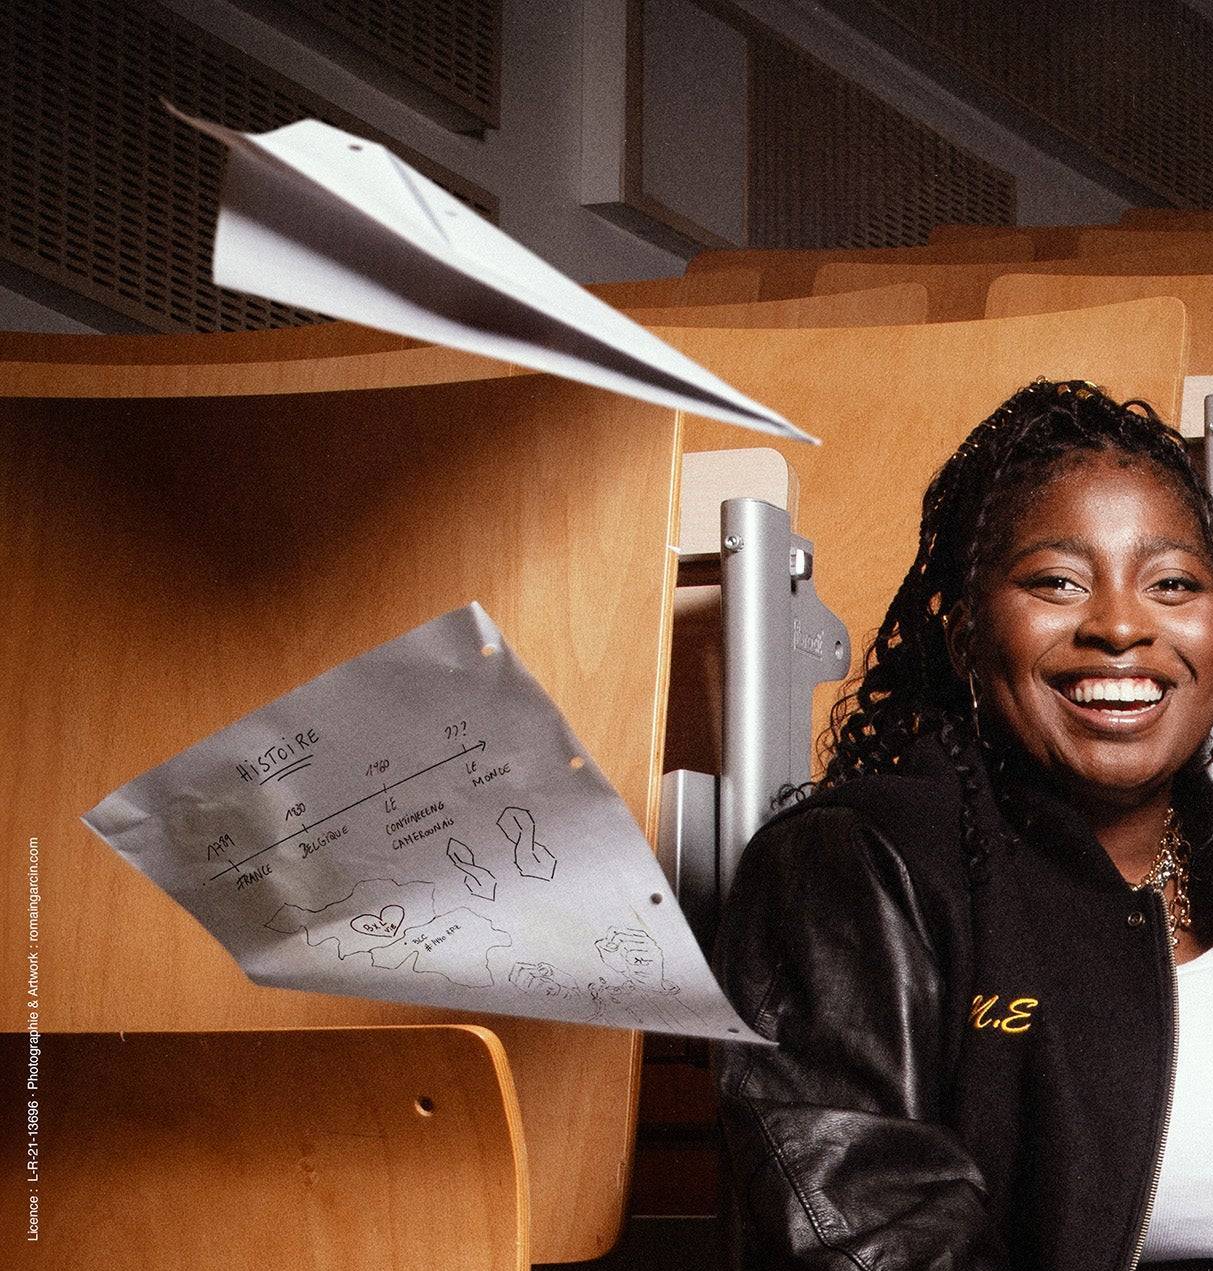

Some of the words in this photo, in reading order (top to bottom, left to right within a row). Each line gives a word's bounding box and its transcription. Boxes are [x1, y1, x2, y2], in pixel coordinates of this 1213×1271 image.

[465, 761, 478, 775] LE
[207, 833, 236, 861] 1789
[285, 802, 307, 821] 1830
[365, 759, 390, 777] 1960
[298, 824, 349, 859] BELGIQUE
[236, 863, 273, 891] FRANCE
